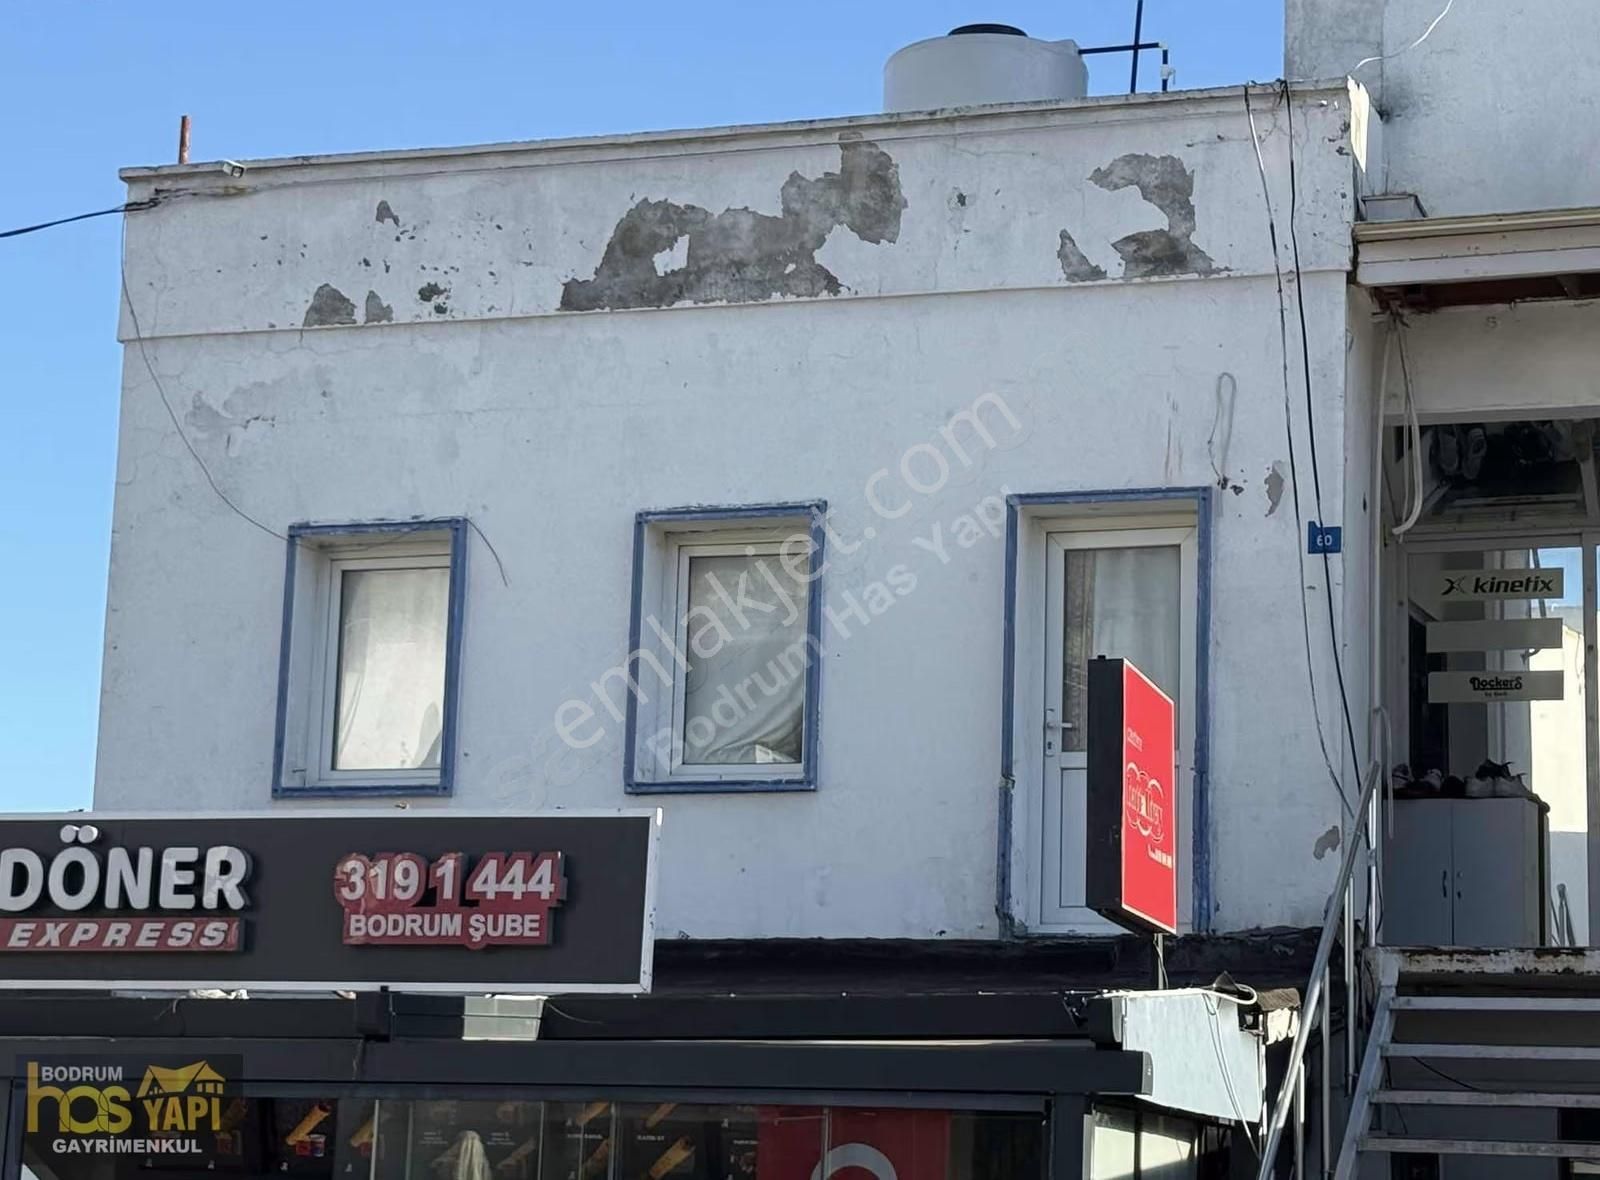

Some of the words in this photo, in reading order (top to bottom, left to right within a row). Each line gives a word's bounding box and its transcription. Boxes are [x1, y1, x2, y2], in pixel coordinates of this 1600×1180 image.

[1316, 534, 1333, 547] 60
[1473, 576, 1554, 594] kinetix
[0, 825, 250, 912] DÖNER
[341, 859, 420, 900] 319
[436, 859, 455, 900] 1
[472, 859, 555, 900] 444
[7, 922, 229, 948] EXPRESS
[350, 913, 462, 937] BODRUM
[468, 913, 541, 942] ŞUBE
